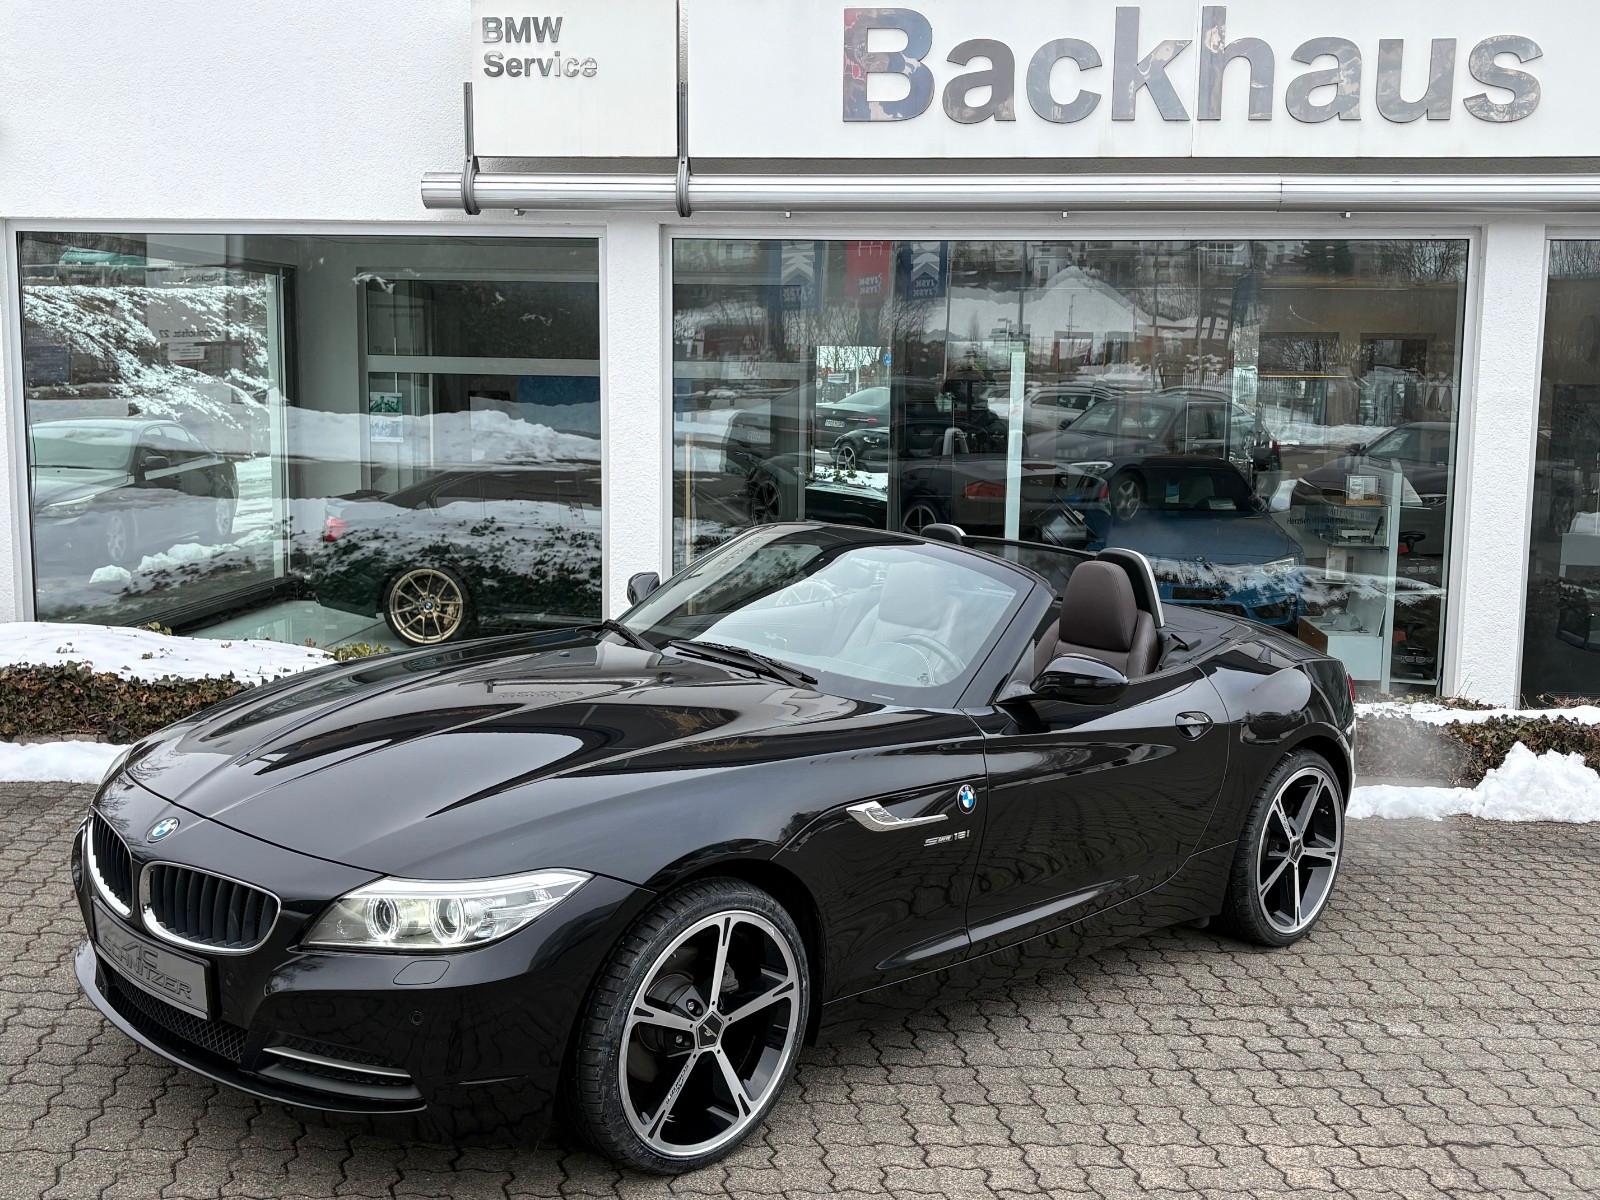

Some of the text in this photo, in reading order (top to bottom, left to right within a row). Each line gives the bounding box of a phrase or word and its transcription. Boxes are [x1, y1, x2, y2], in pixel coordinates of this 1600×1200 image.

[482, 16, 563, 44] BMW
[483, 50, 598, 78] Service
[842, 4, 1544, 124] Backhaus
[103, 935, 192, 1000] SCHNITZER
